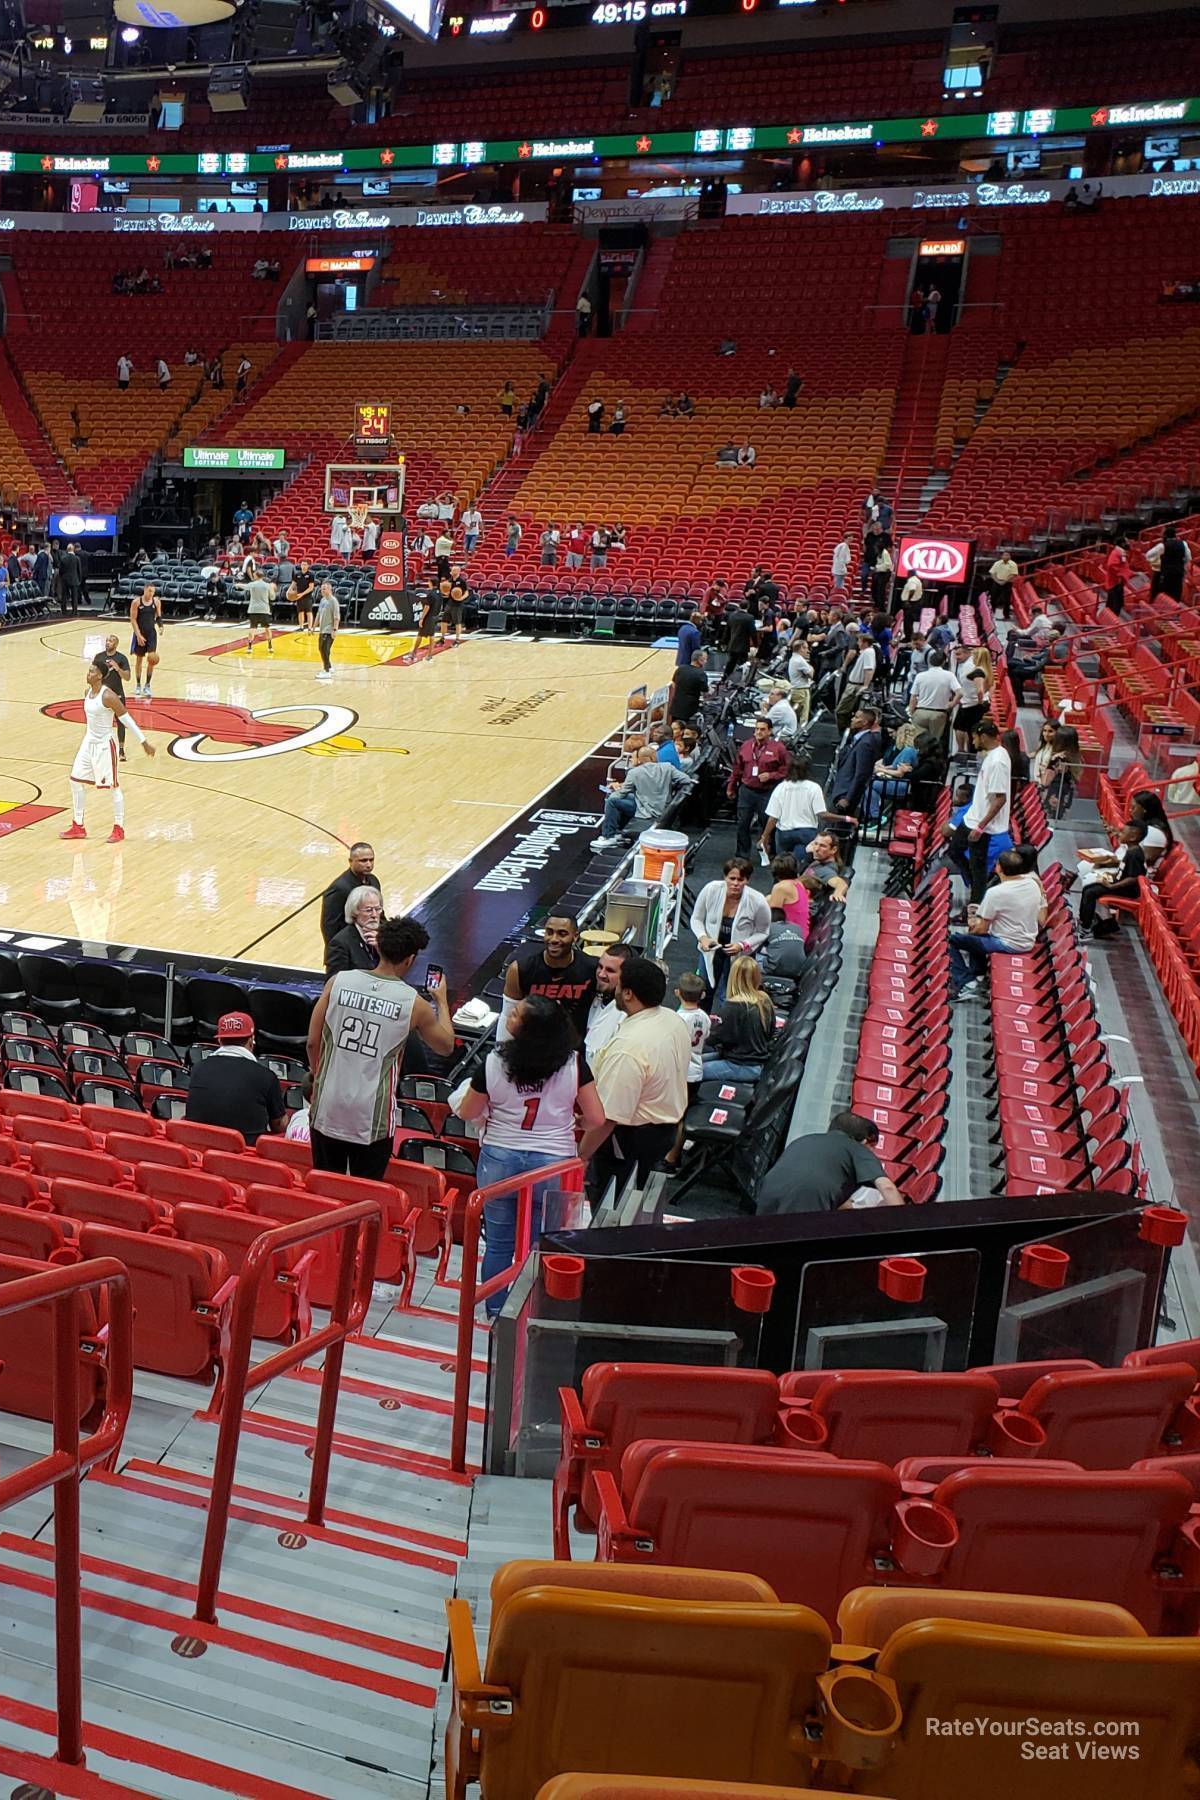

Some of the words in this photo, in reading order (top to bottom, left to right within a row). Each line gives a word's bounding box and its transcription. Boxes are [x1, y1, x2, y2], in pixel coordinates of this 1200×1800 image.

[532, 10, 544, 28] 0
[592, 1, 647, 23] 49:15
[651, 3, 677, 16] QTR
[678, 1, 687, 15] 1
[25, 114, 51, 123] Issue
[1108, 103, 1184, 124] Heineken
[802, 124, 874, 143] Heineken
[532, 140, 595, 157] Heineken
[54, 157, 110, 170] Heineken
[288, 153, 344, 169] Heineken
[359, 406, 387, 418] 49:14
[361, 418, 384, 435] 24
[193, 449, 229, 460] Ultimate
[237, 450, 275, 461] Ultimate
[912, 549, 952, 571] KIA
[367, 611, 403, 621] adidas
[511, 824, 579, 858] Baptist
[473, 854, 549, 892] Health
[529, 978, 592, 999] HEAT
[338, 988, 402, 1021] WHITESIDE
[337, 1016, 382, 1058] 21
[691, 1029, 704, 1048] 3
[521, 1097, 541, 1130] 1
[384, 1399, 396, 1410] 8
[281, 1533, 302, 1548] 10
[176, 1636, 198, 1655] 11
